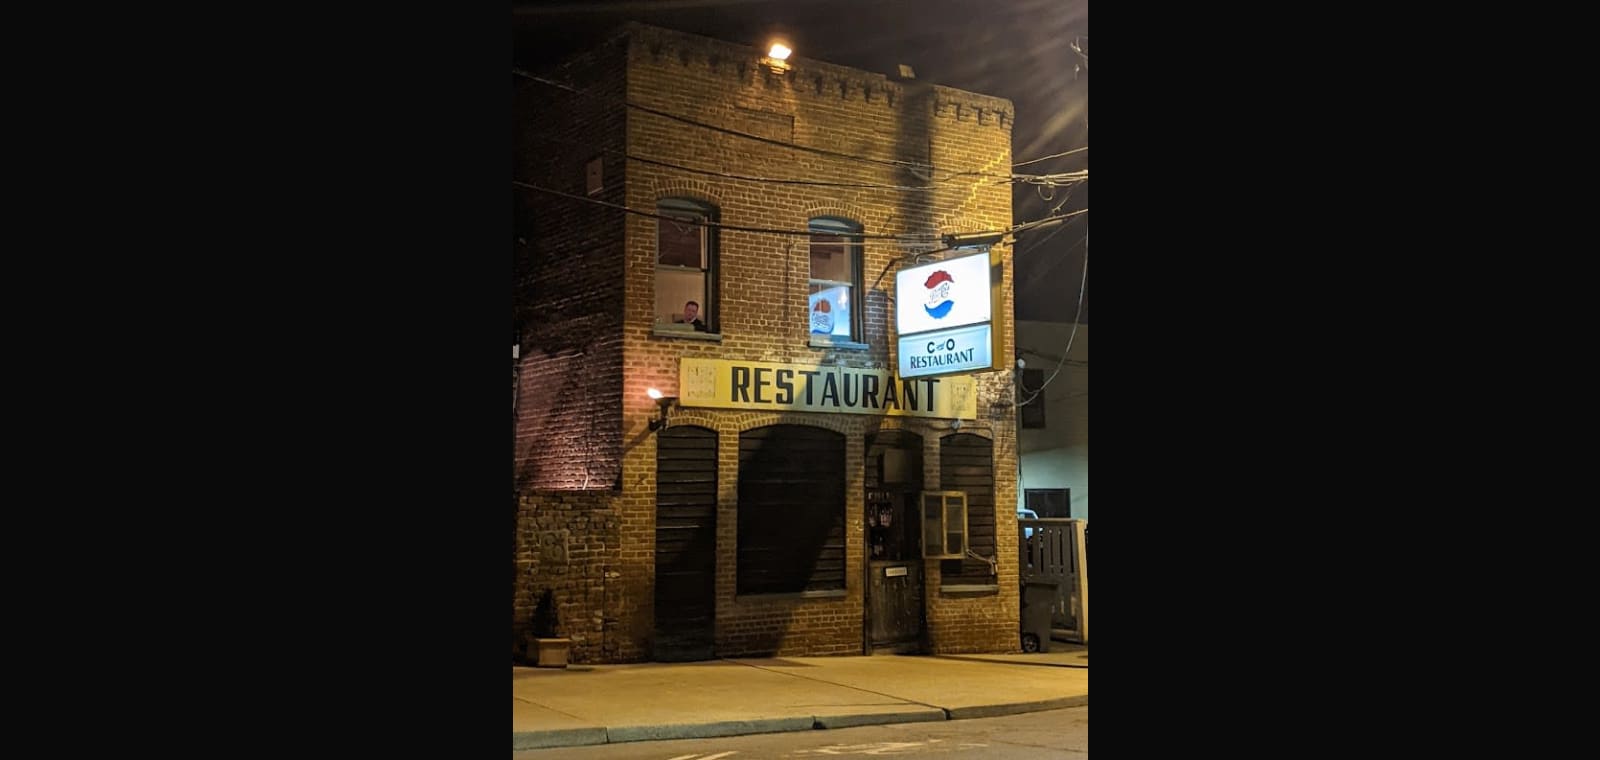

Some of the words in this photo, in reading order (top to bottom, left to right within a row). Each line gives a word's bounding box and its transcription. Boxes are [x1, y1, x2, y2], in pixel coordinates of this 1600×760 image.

[927, 341, 935, 353] C
[946, 338, 955, 351] O
[910, 348, 974, 369] RESTAURANT
[731, 366, 940, 412] RESTAURANT
